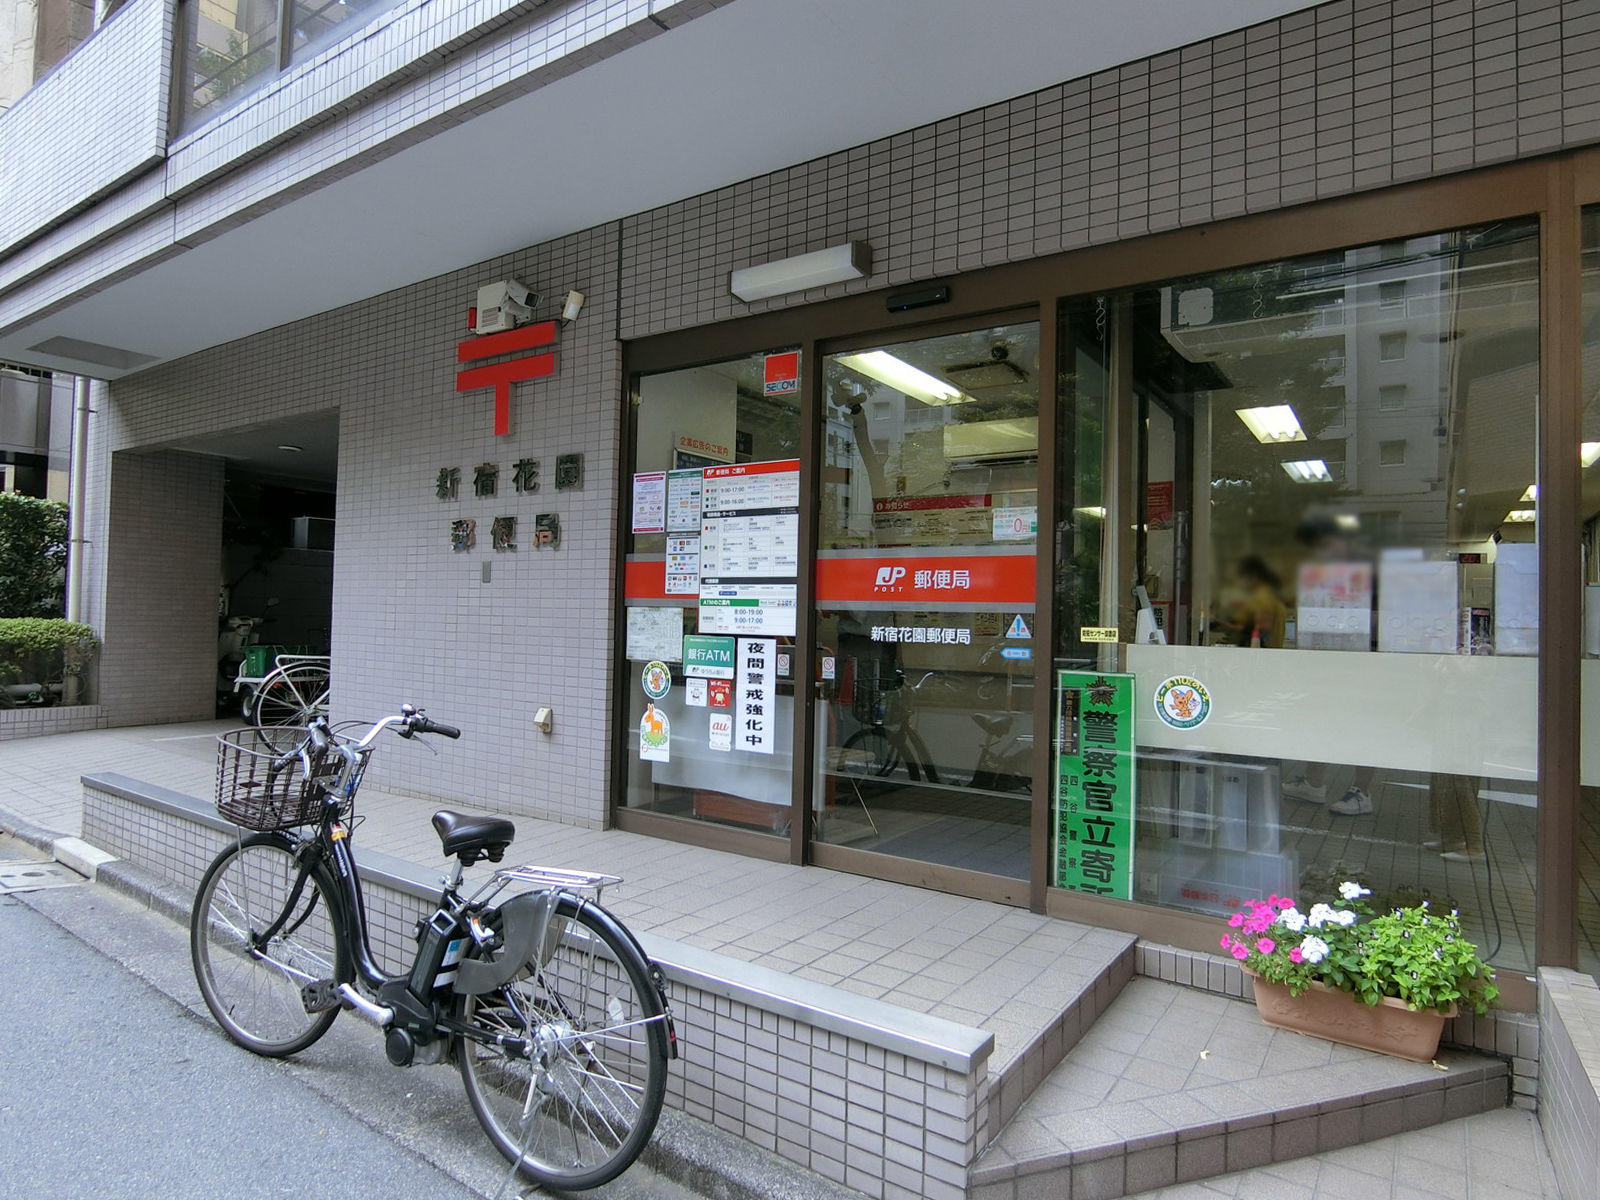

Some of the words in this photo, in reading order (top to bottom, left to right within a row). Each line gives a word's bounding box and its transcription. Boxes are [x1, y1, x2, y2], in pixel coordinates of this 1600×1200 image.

[766, 380, 796, 392] SECOM
[436, 454, 585, 500] 新宿花園
[451, 513, 562, 551] 郵便局
[914, 569, 971, 589] 郵便局
[870, 626, 971, 645] 新宿花園郵便局
[687, 648, 731, 662] 銀行ATM
[700, 668, 725, 676] ゆうちょ銀行
[745, 642, 765, 746] 夜間警戒強化中
[712, 721, 729, 731] au
